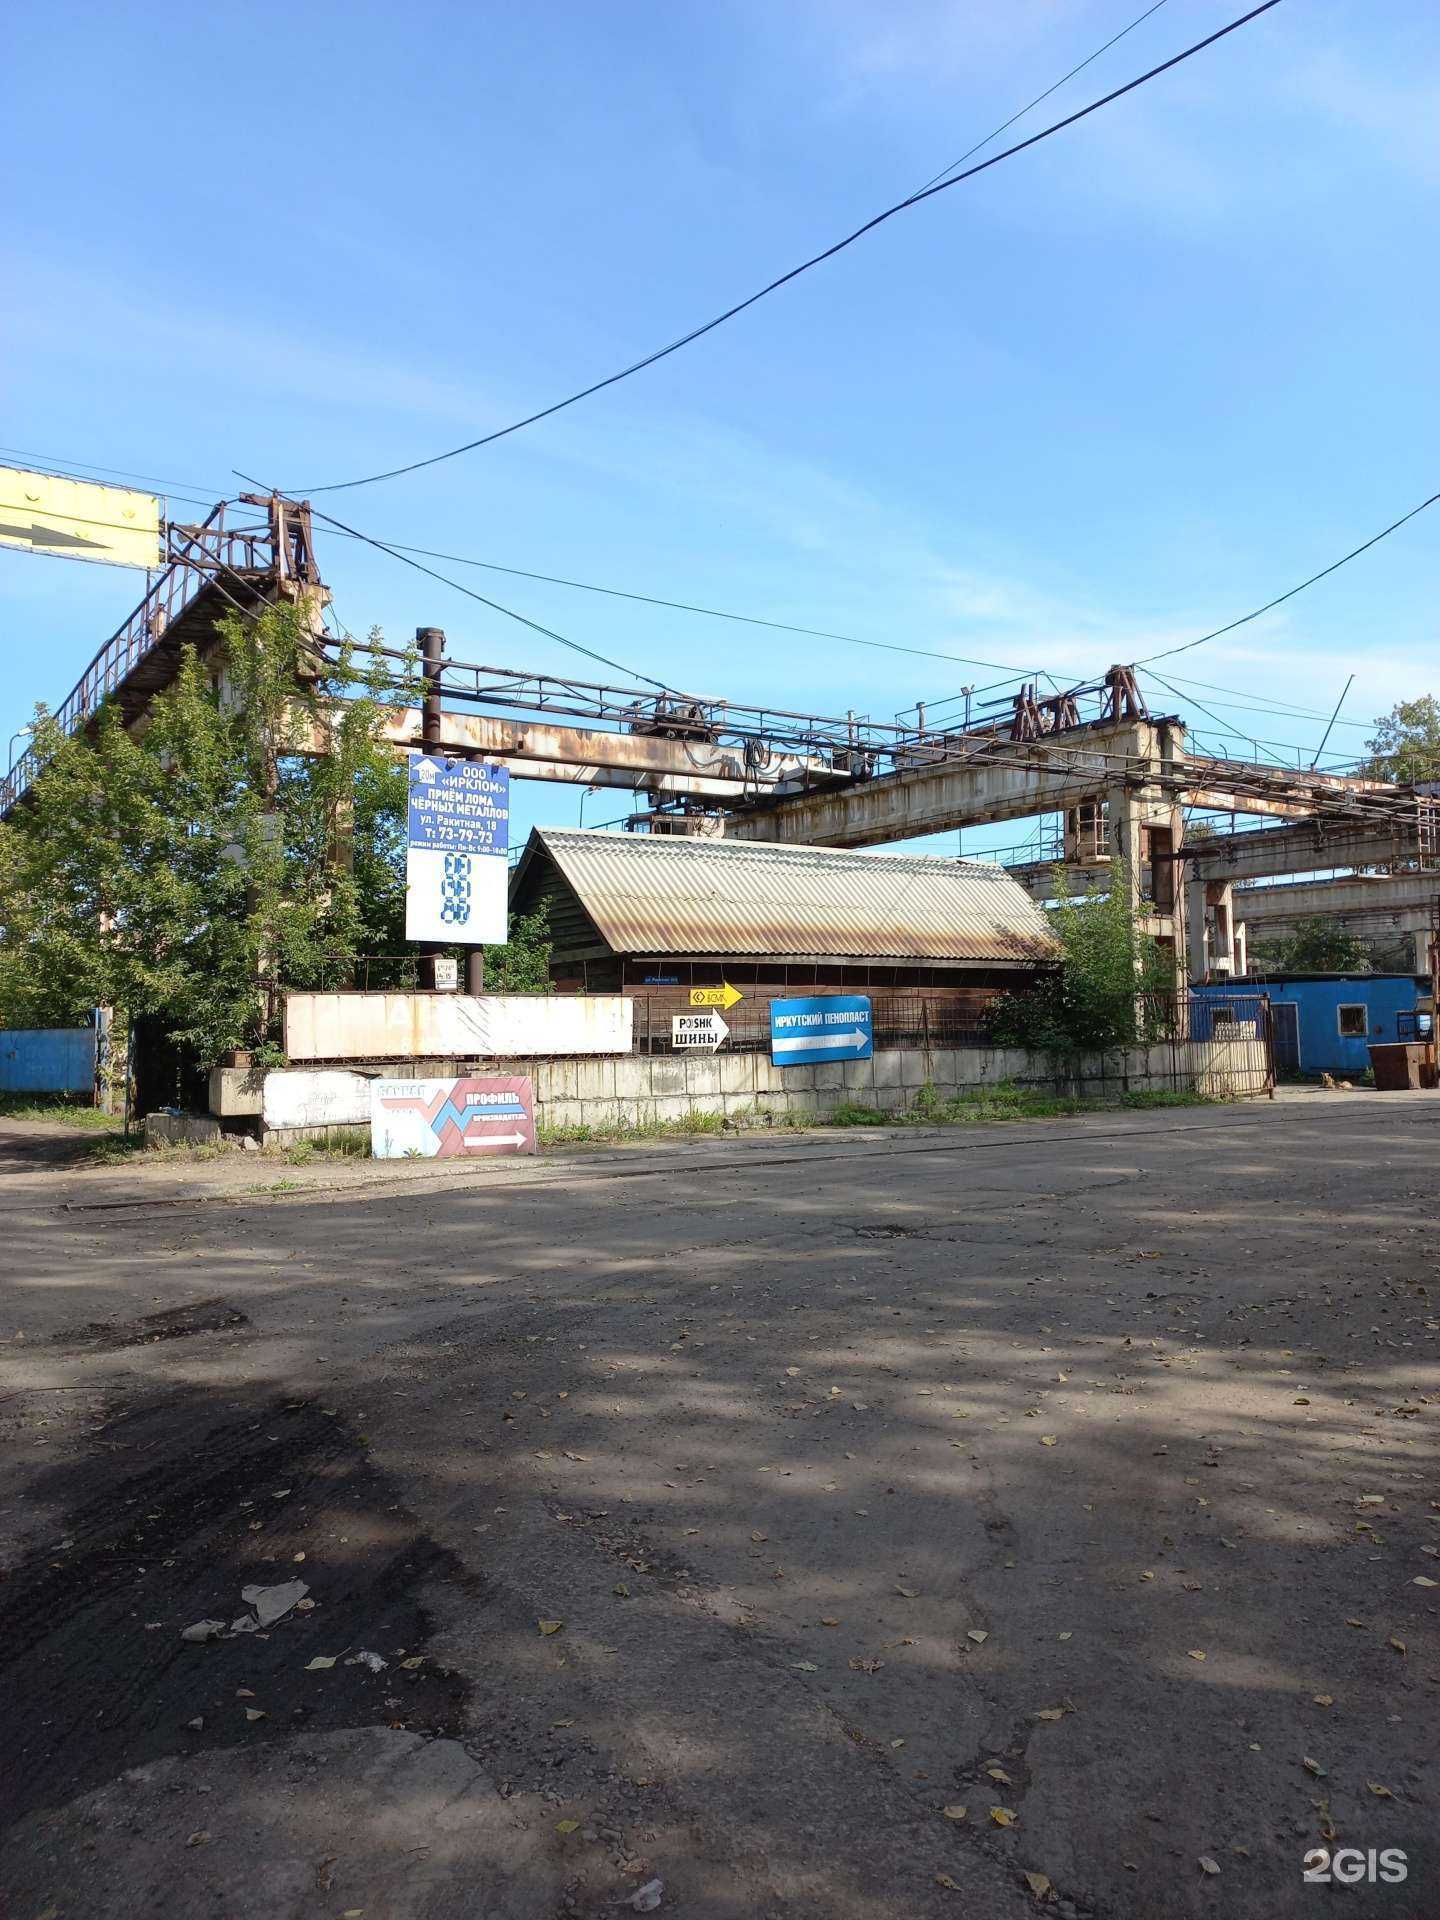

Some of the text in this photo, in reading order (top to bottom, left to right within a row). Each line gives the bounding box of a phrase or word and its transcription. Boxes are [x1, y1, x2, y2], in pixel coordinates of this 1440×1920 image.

[463, 767, 487, 779] ООО
[441, 776, 506, 793] «ИРКЛОМ»
[428, 788, 494, 807] ПРИЁМ ЛОМА
[411, 796, 508, 820] ЧЁРНЫХ МЕТАЛЛОВ
[420, 814, 435, 825] ул.
[486, 820, 497, 831] 18
[438, 826, 493, 844] 73-79-73
[774, 1010, 870, 1028] ИРКУТСКИЙ ПЕНОПЛАСТ
[675, 1033, 718, 1044] ШИНЫ
[466, 1092, 520, 1106] ПРОФИЛЬ
